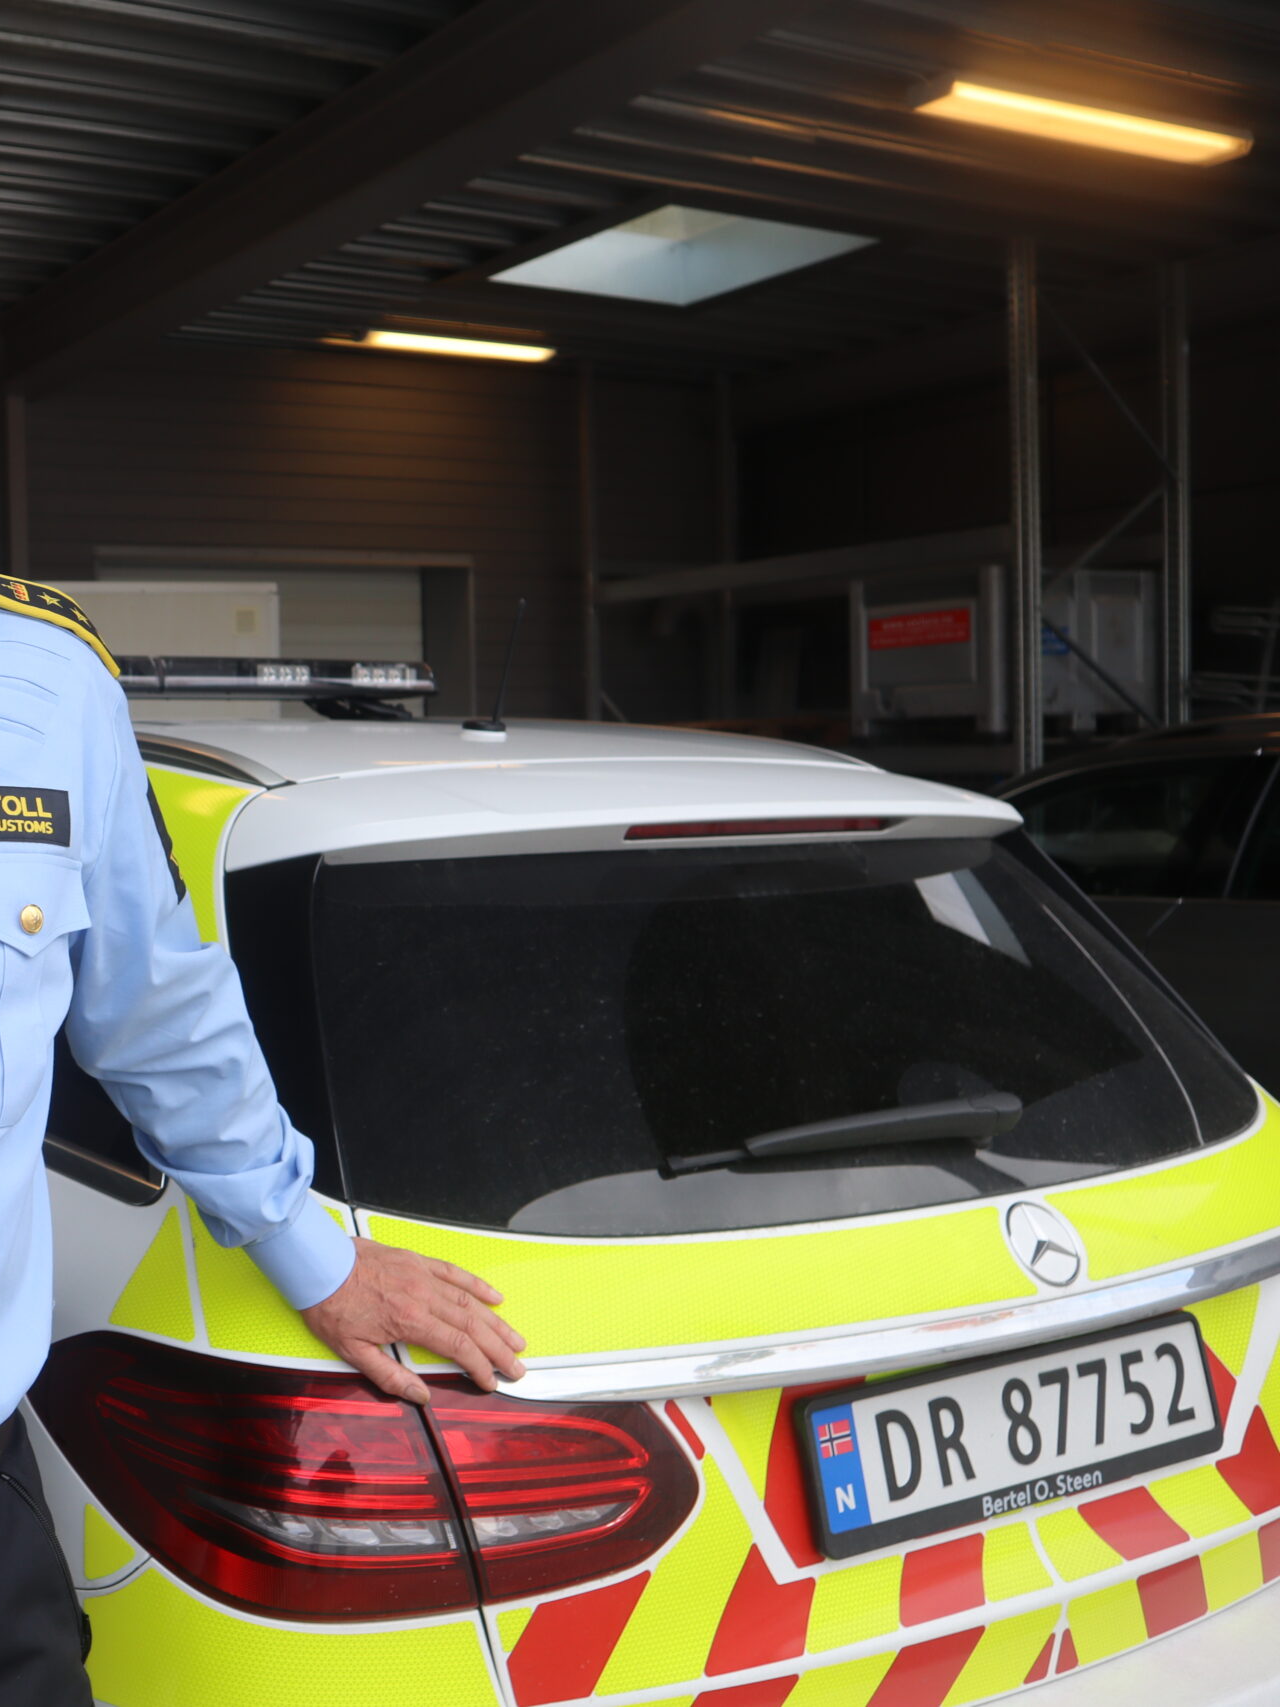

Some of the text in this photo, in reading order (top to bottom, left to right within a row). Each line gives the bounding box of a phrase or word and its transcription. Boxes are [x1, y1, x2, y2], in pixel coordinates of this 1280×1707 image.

[874, 1342, 1196, 1503] DR 87752
[834, 1482, 857, 1514] N
[981, 1470, 1104, 1518] Bertel O. Steen
